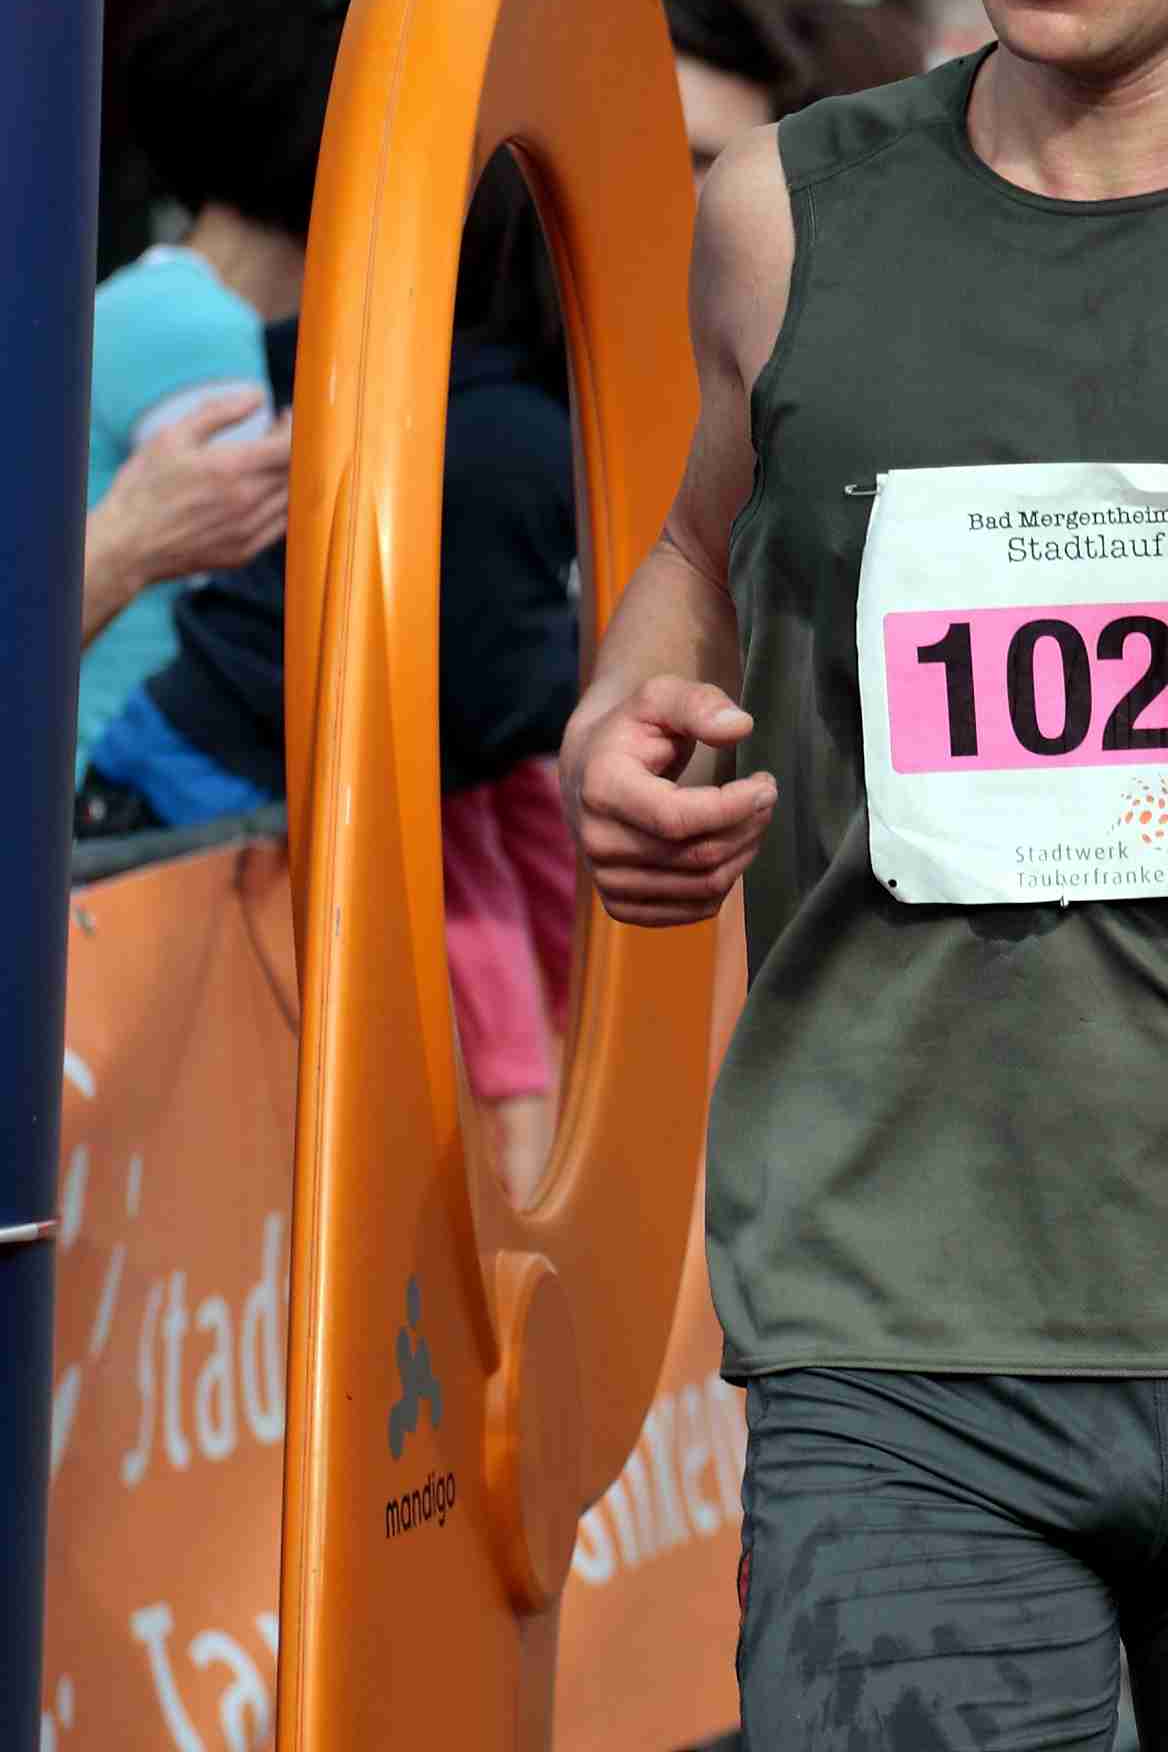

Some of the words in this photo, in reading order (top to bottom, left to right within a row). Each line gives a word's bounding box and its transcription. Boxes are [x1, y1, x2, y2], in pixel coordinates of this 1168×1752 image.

[967, 511, 1013, 531] Bad
[1007, 532, 1166, 563] Stadtlauf
[1015, 840, 1130, 864] Stadtwerk
[385, 1472, 456, 1539] mandigo
